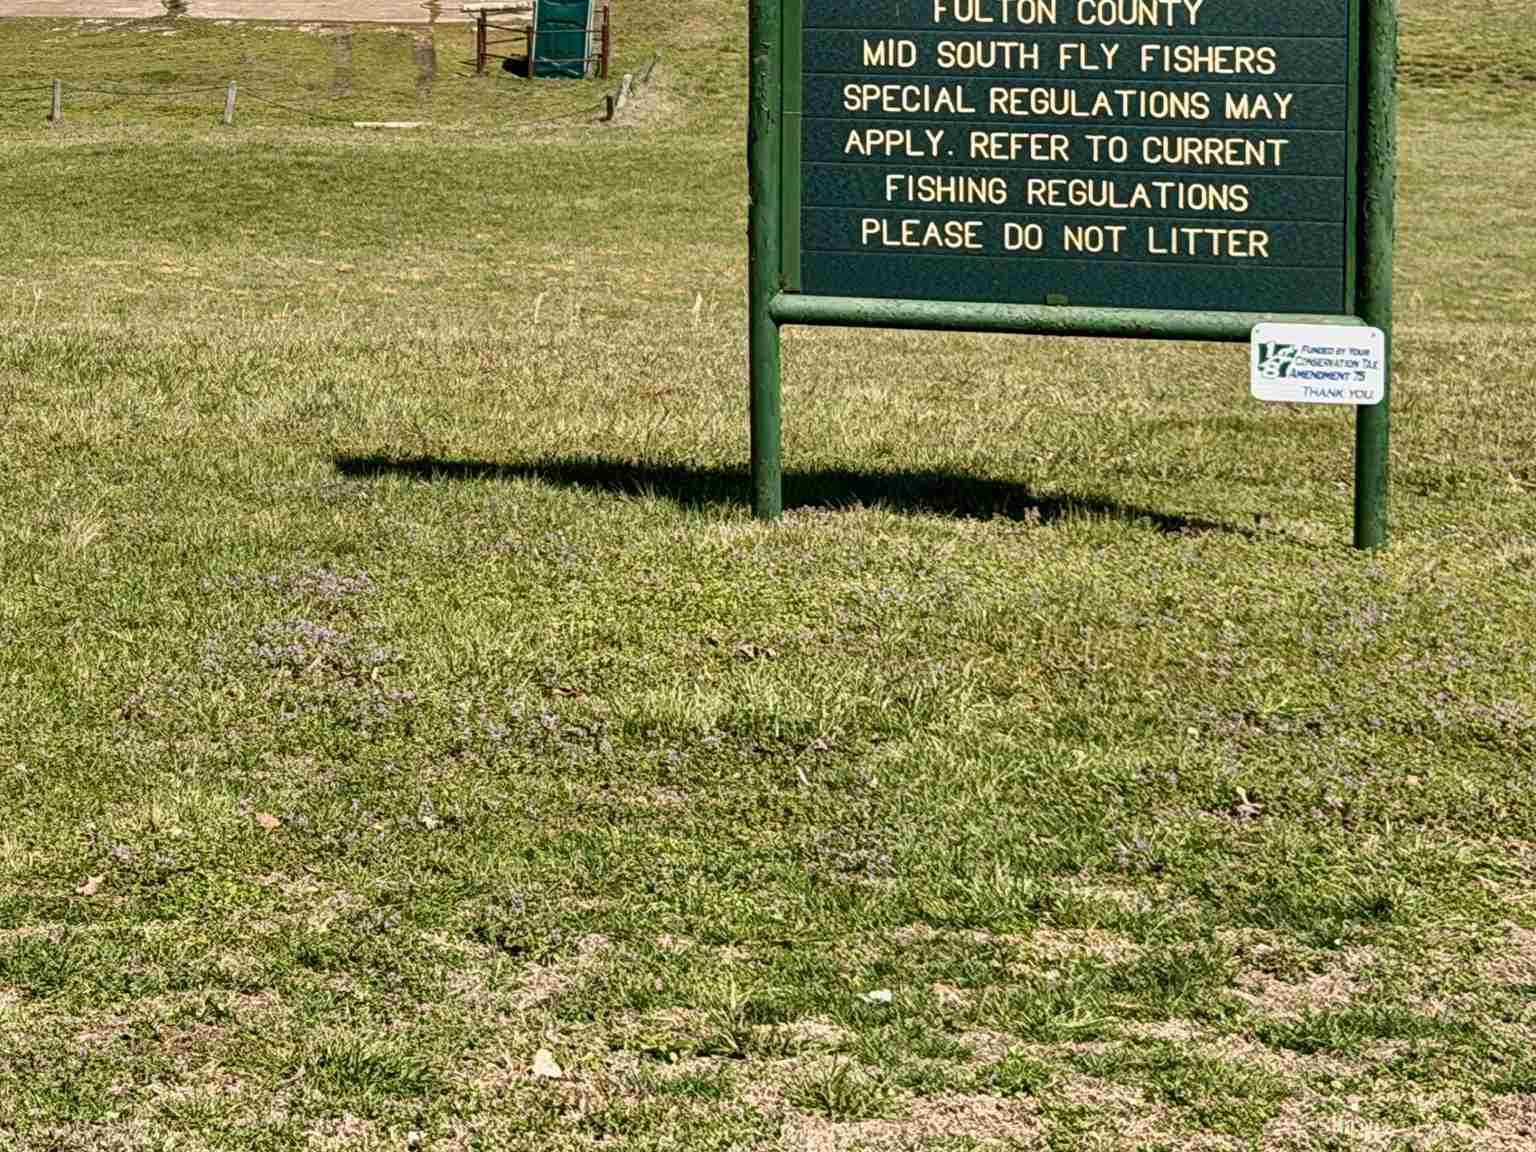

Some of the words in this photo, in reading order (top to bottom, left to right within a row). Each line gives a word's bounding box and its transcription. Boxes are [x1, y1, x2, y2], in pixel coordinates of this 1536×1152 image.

[864, 39, 916, 67] MID
[937, 41, 1038, 69] SOUTH
[1060, 43, 1119, 70] FLY
[1141, 44, 1276, 74] FISHERS
[844, 84, 975, 113] SPECIAL
[990, 88, 1210, 119] REGULATIONS
[1226, 93, 1292, 119] MAY
[845, 129, 953, 156] APPLY.
[971, 132, 1069, 161] REFER
[1085, 135, 1127, 162] TO
[1143, 136, 1288, 165] CURRENT
[886, 175, 1006, 204] FISHING
[1028, 179, 1248, 211] REGULATIONS
[862, 218, 982, 248] PLEASE
[1005, 223, 1042, 250] DO
[1064, 226, 1126, 252] NOT
[1149, 227, 1268, 257] LITTER
[1303, 385, 1344, 399] THANK
